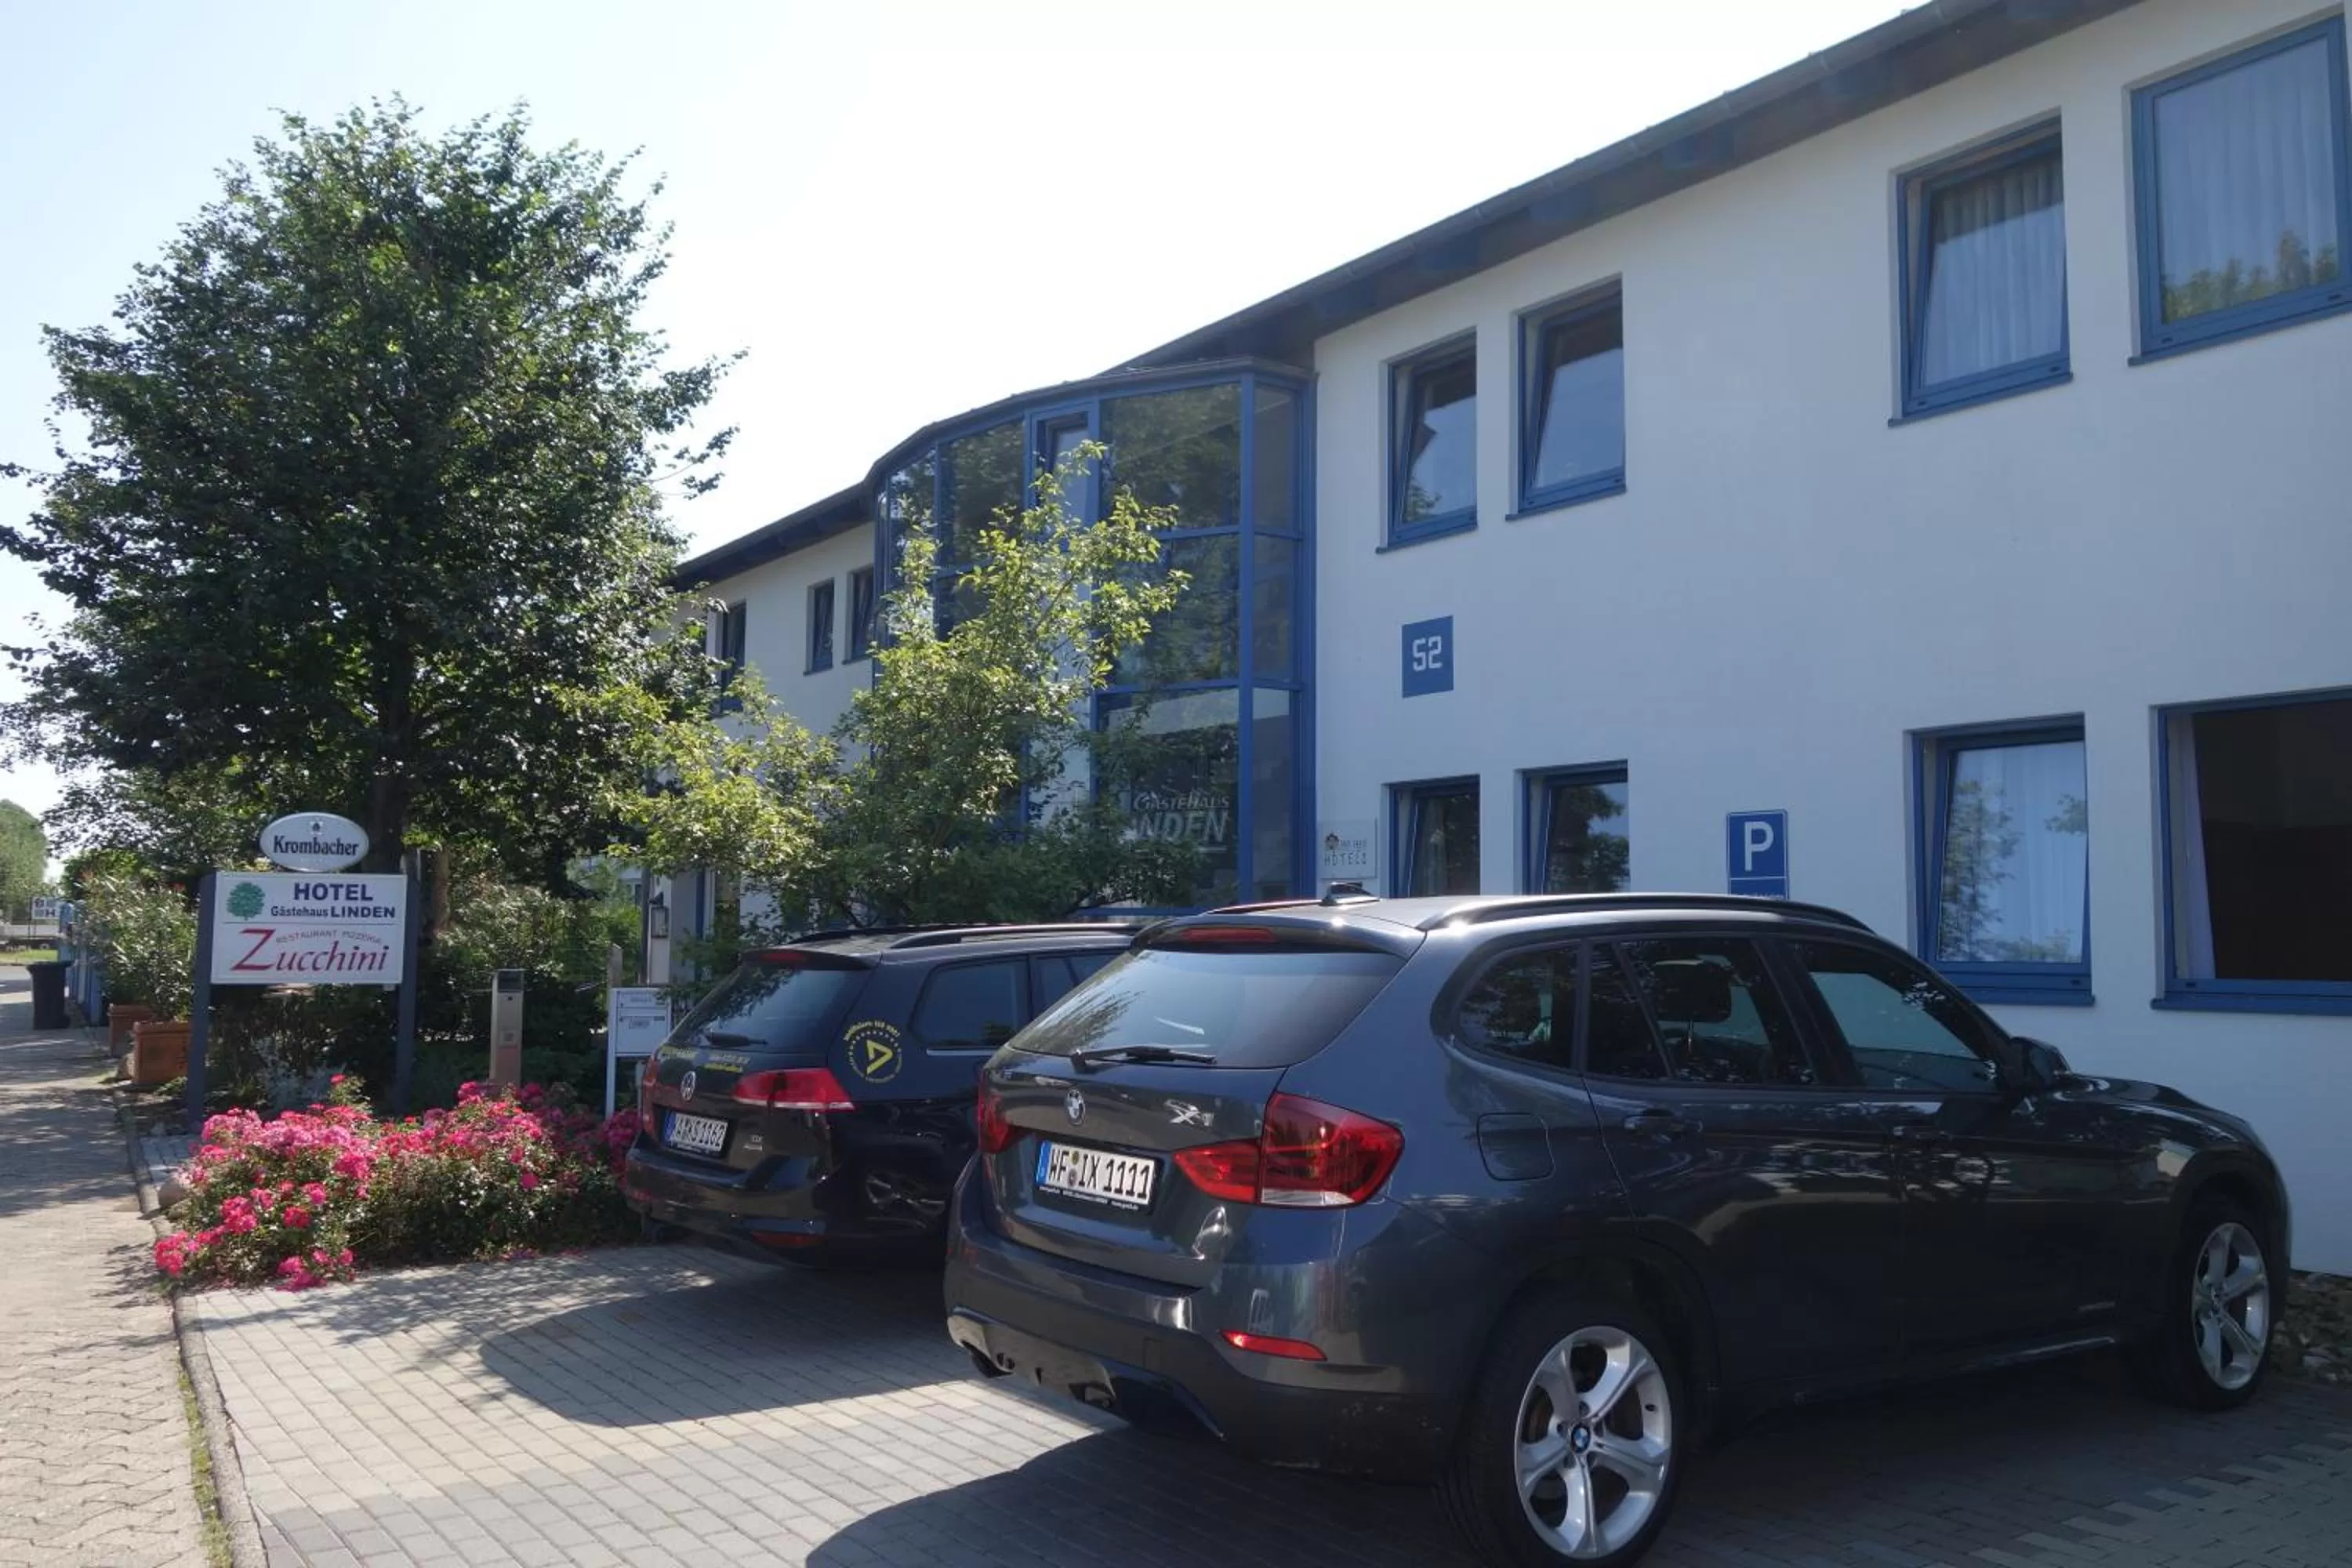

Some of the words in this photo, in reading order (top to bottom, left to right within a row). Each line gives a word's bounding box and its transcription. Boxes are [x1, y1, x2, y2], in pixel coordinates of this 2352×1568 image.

[1412, 636, 1443, 672] 52
[274, 835, 359, 856] Krombacher
[1744, 821, 1774, 872] P
[293, 883, 374, 902] HOTEL
[270, 906, 328, 918] Gästehaus
[330, 906, 396, 918] LINDEN
[230, 928, 390, 972] Zucchini
[1103, 1159, 1151, 1199] 1111
